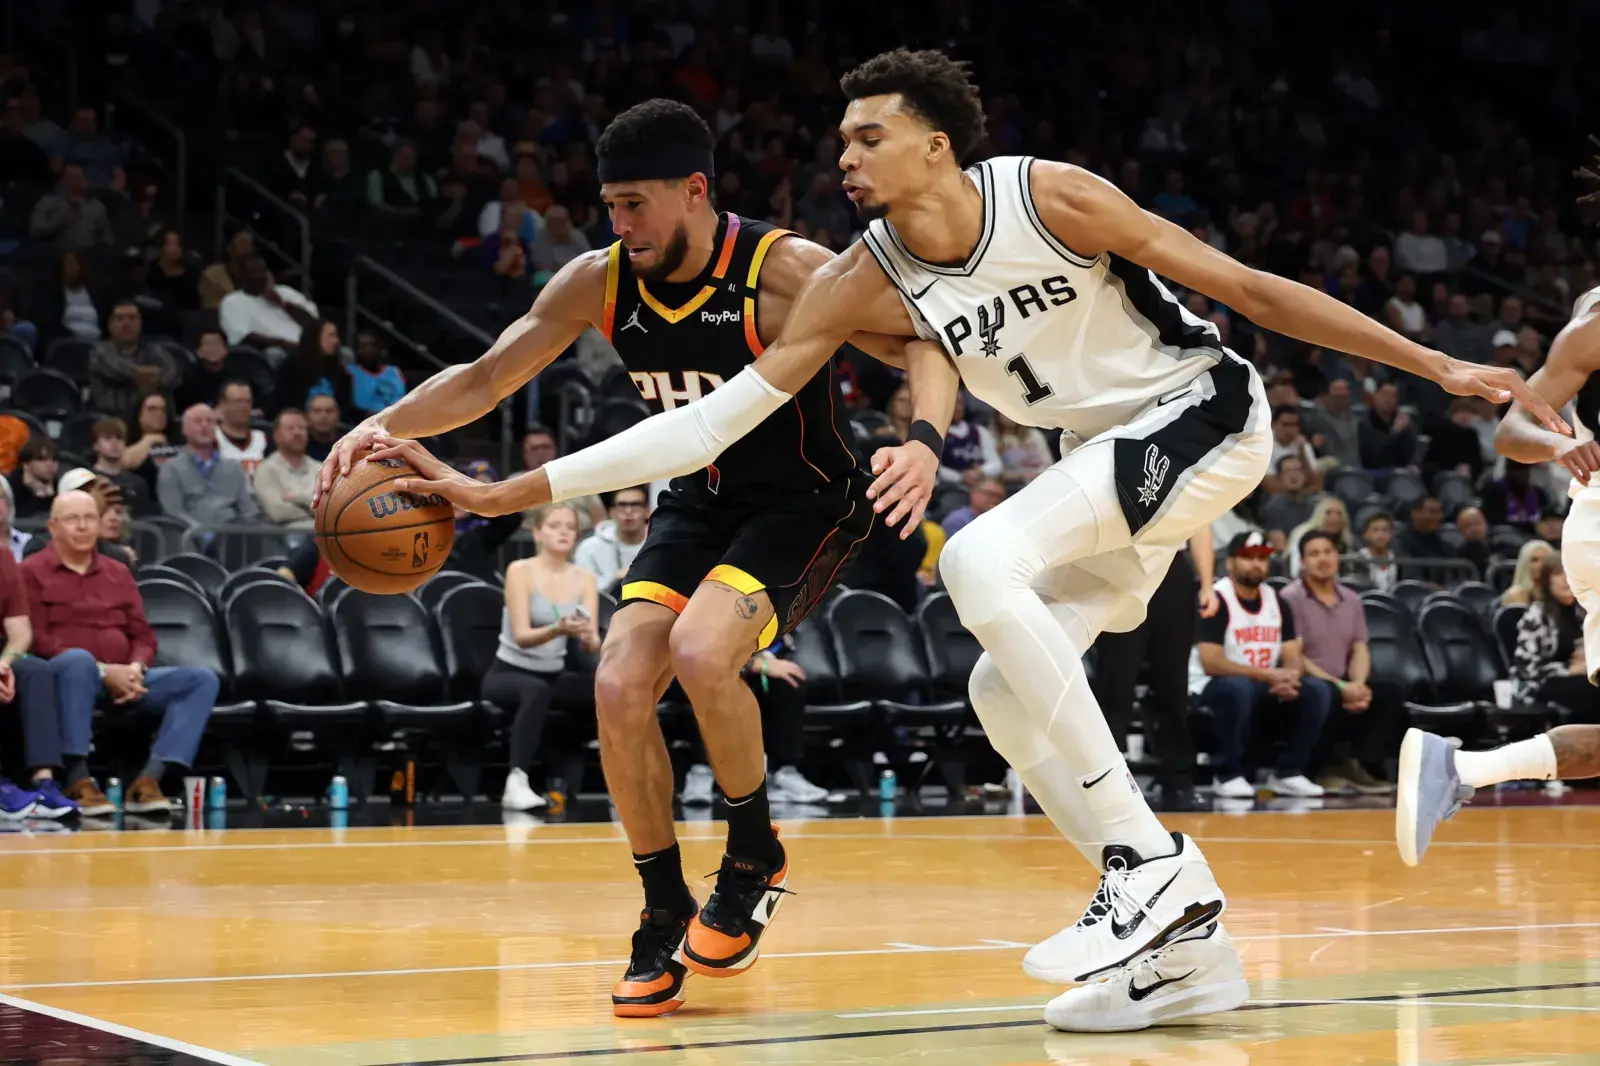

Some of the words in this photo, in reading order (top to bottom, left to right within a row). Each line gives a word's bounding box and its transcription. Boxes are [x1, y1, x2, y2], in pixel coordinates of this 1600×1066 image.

[701, 310, 740, 325] PayPal
[920, 275, 1078, 359] PURS
[627, 370, 726, 412] PH
[1004, 352, 1056, 407] 1
[1244, 648, 1272, 669] 32
